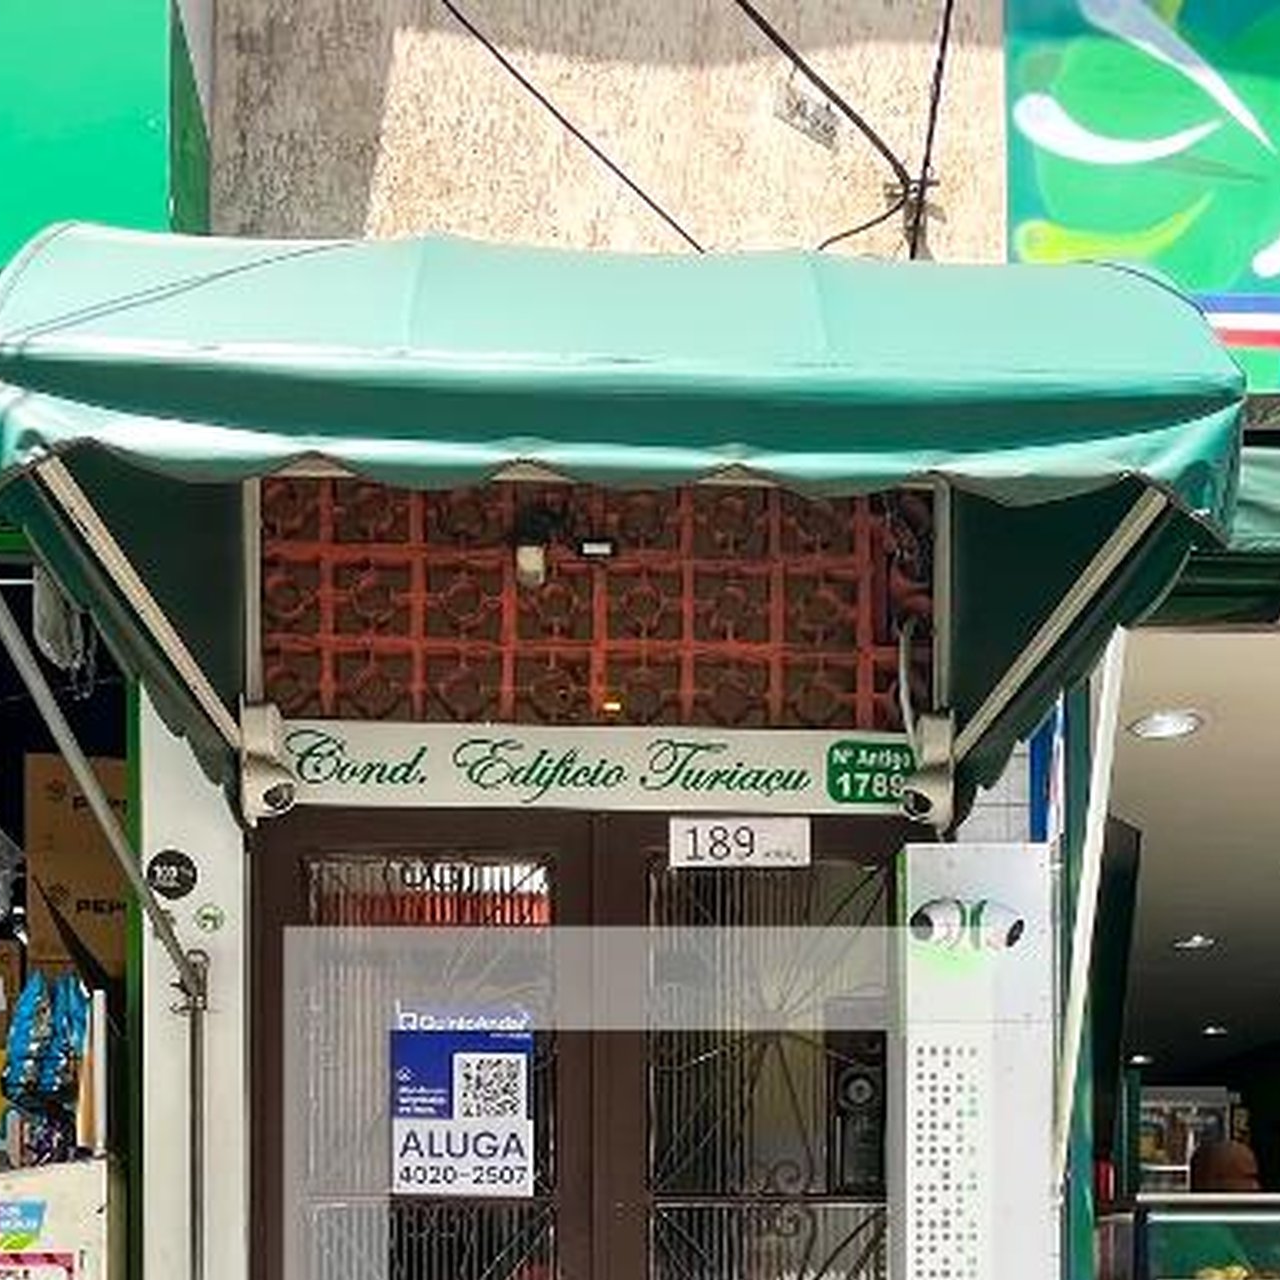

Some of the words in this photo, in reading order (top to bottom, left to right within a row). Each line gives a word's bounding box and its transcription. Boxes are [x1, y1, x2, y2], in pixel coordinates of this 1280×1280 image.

[285, 730, 427, 784] Cond.
[836, 773, 904, 798] 1789
[686, 826, 755, 860] 189
[400, 1131, 524, 1158] ALUGA
[400, 1166, 528, 1184] 4020-2507
